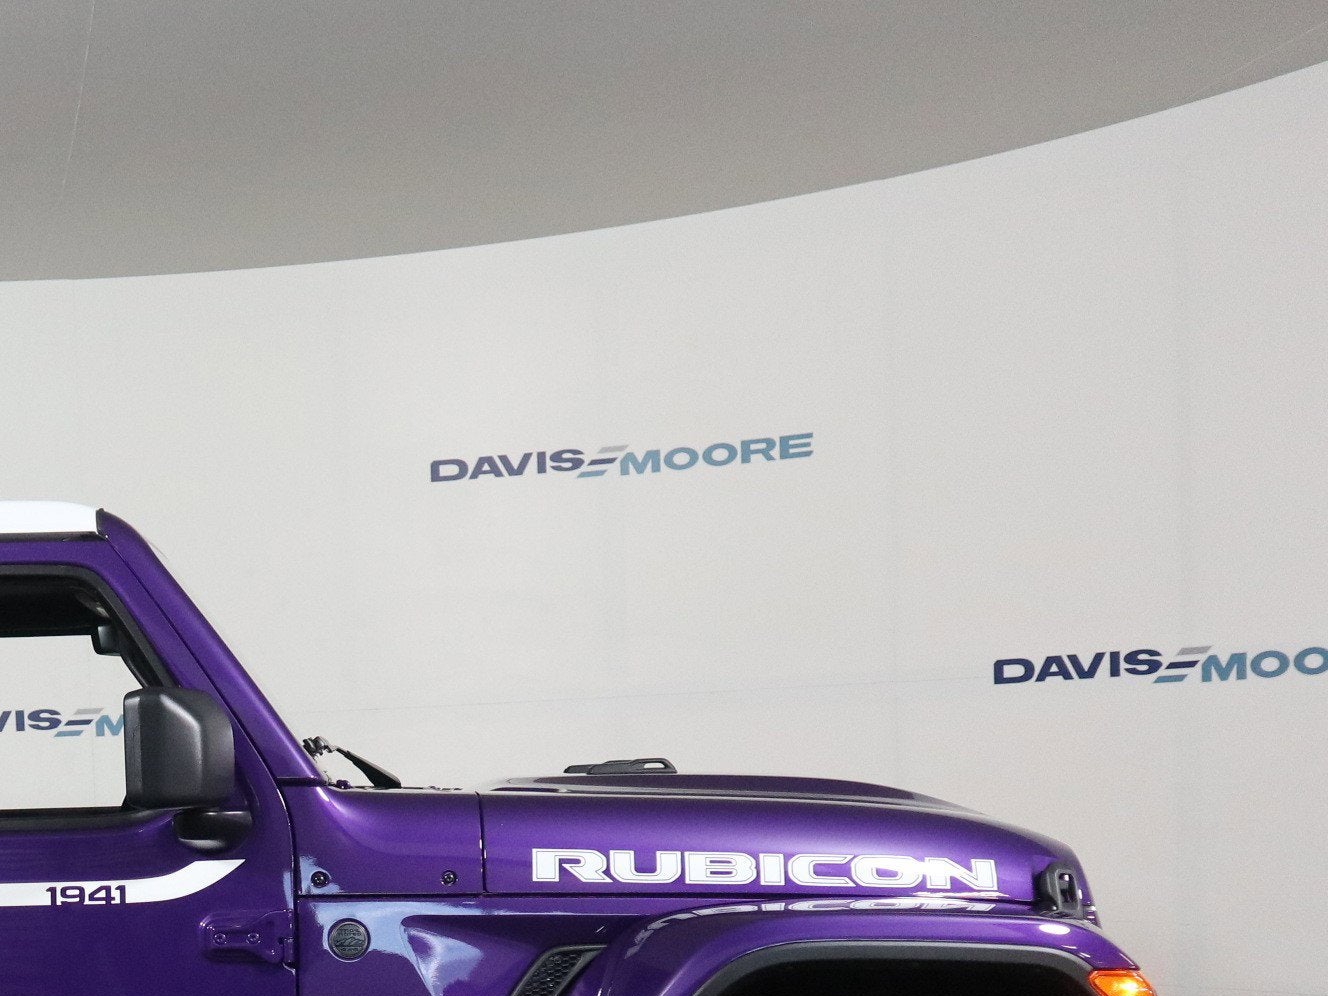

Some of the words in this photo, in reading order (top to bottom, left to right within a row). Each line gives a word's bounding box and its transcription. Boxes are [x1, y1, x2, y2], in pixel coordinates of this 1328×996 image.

[430, 448, 585, 483] DAVIS
[620, 432, 814, 476] MOORE
[993, 648, 1163, 685] DAVIS
[531, 848, 998, 891] RUBICON
[45, 884, 127, 906] 1941
